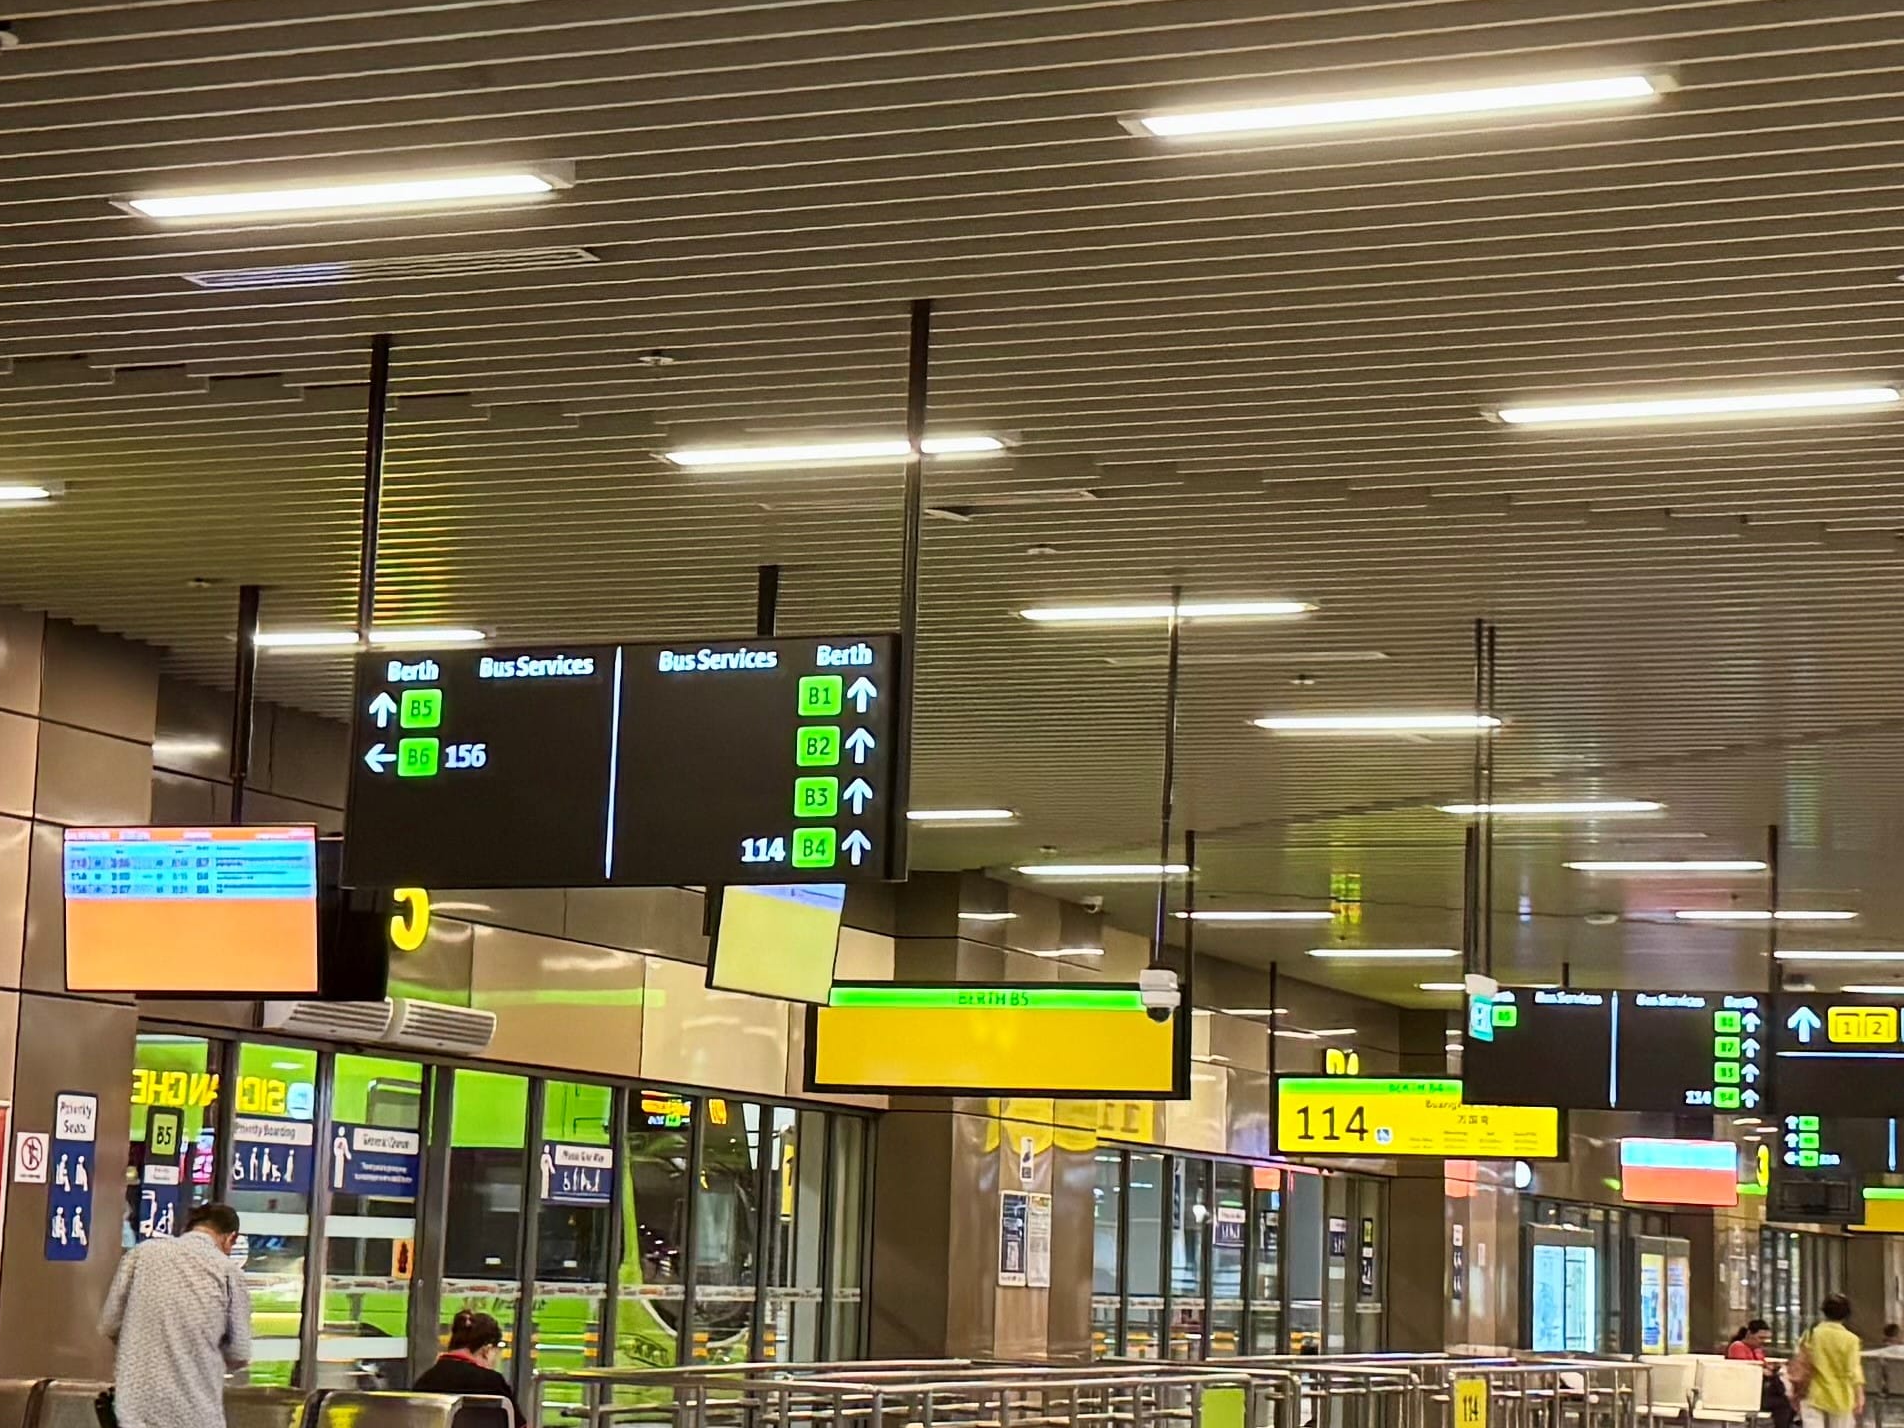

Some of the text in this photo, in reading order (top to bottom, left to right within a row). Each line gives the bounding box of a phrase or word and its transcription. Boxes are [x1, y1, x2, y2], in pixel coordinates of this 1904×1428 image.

[658, 642, 873, 673] Bus Services Berth
[387, 654, 594, 683] Berth Bus Services
[809, 686, 832, 706] B1
[409, 698, 433, 718] B5
[407, 742, 487, 770] B6 156
[806, 735, 831, 756] B2
[804, 786, 829, 807] B3
[740, 837, 828, 864] 114 B4
[957, 991, 1030, 1007] BERTH B5
[1843, 1022, 1852, 1035] 1
[1871, 1021, 1883, 1035] 2
[1296, 1105, 1369, 1142] 114
[1462, 1393, 1479, 1423] 114
